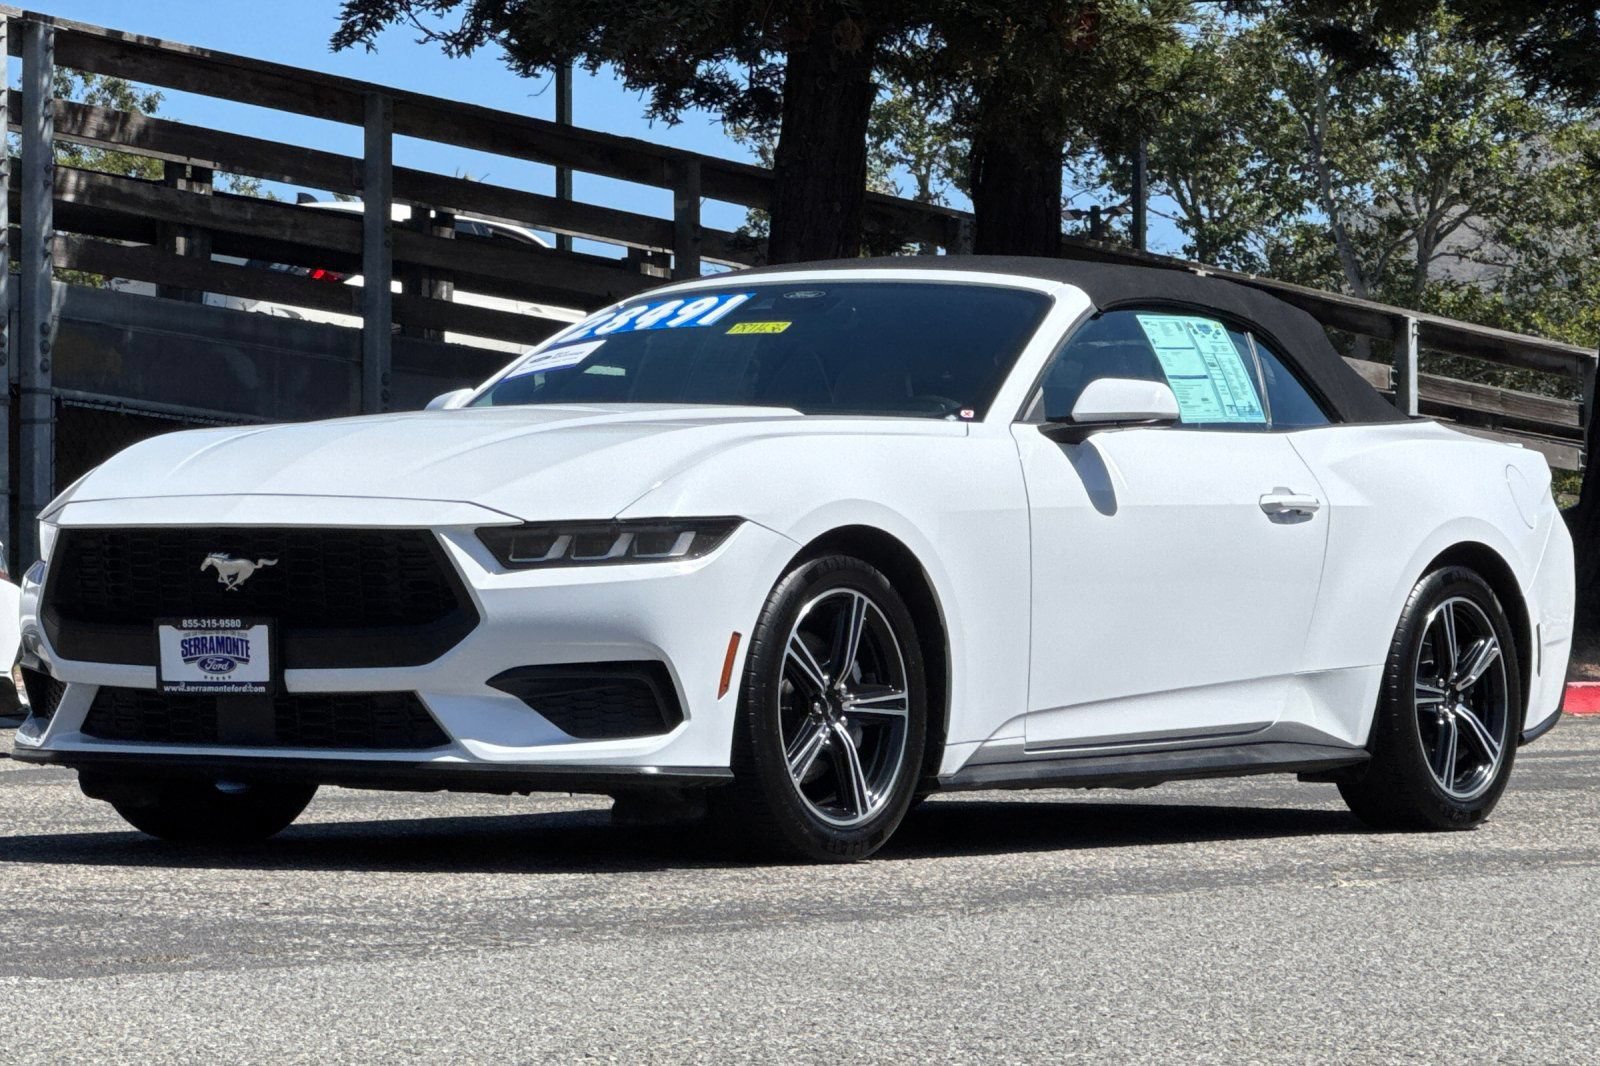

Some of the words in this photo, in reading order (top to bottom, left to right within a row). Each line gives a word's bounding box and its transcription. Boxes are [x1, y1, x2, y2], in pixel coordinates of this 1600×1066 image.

[182, 619, 241, 628] 855-315-9580
[180, 636, 250, 658] SERRAMONTE
[204, 658, 229, 671] Ford
[163, 683, 266, 693] www.serramonteford.com
